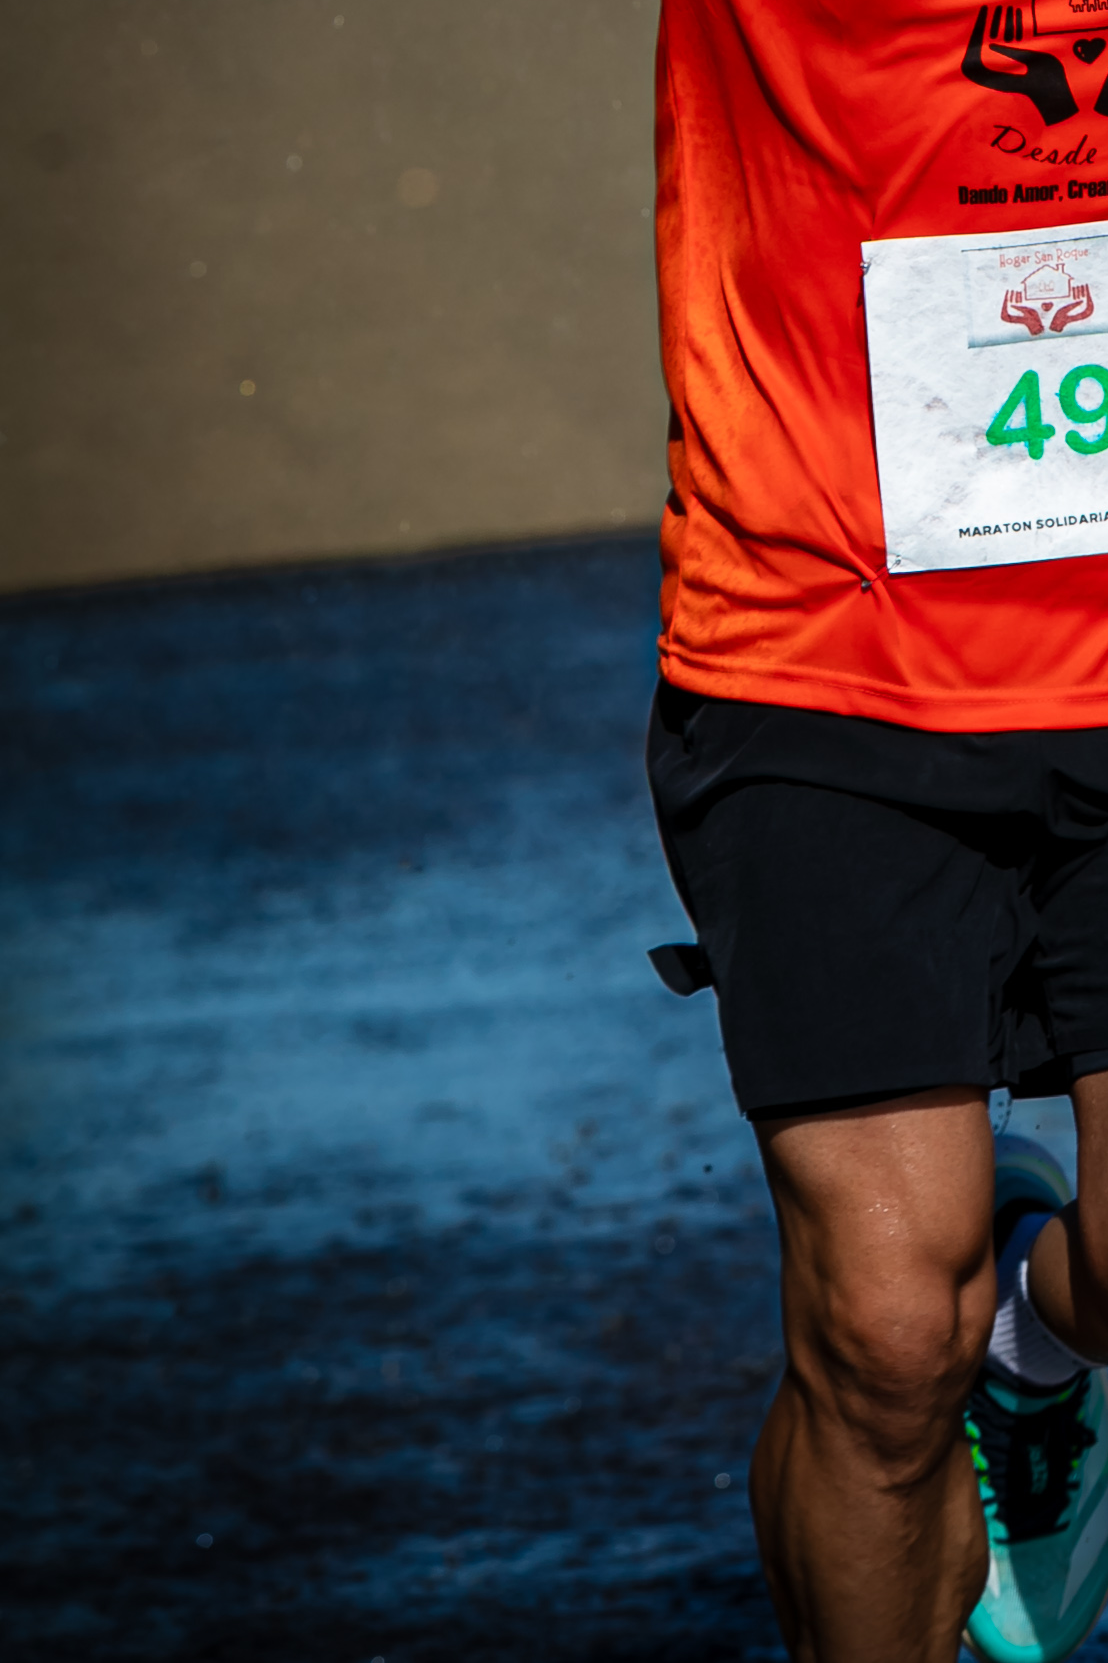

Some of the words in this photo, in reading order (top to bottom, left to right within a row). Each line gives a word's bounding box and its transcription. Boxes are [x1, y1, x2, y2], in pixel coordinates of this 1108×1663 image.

[990, 125, 1097, 165] Desde
[958, 186, 1008, 205] Dando
[1013, 184, 1063, 202] Amor,
[999, 254, 1031, 268] Hogar
[1035, 251, 1053, 264] San
[1056, 248, 1089, 262] Roque
[958, 521, 1032, 538] MARATON
